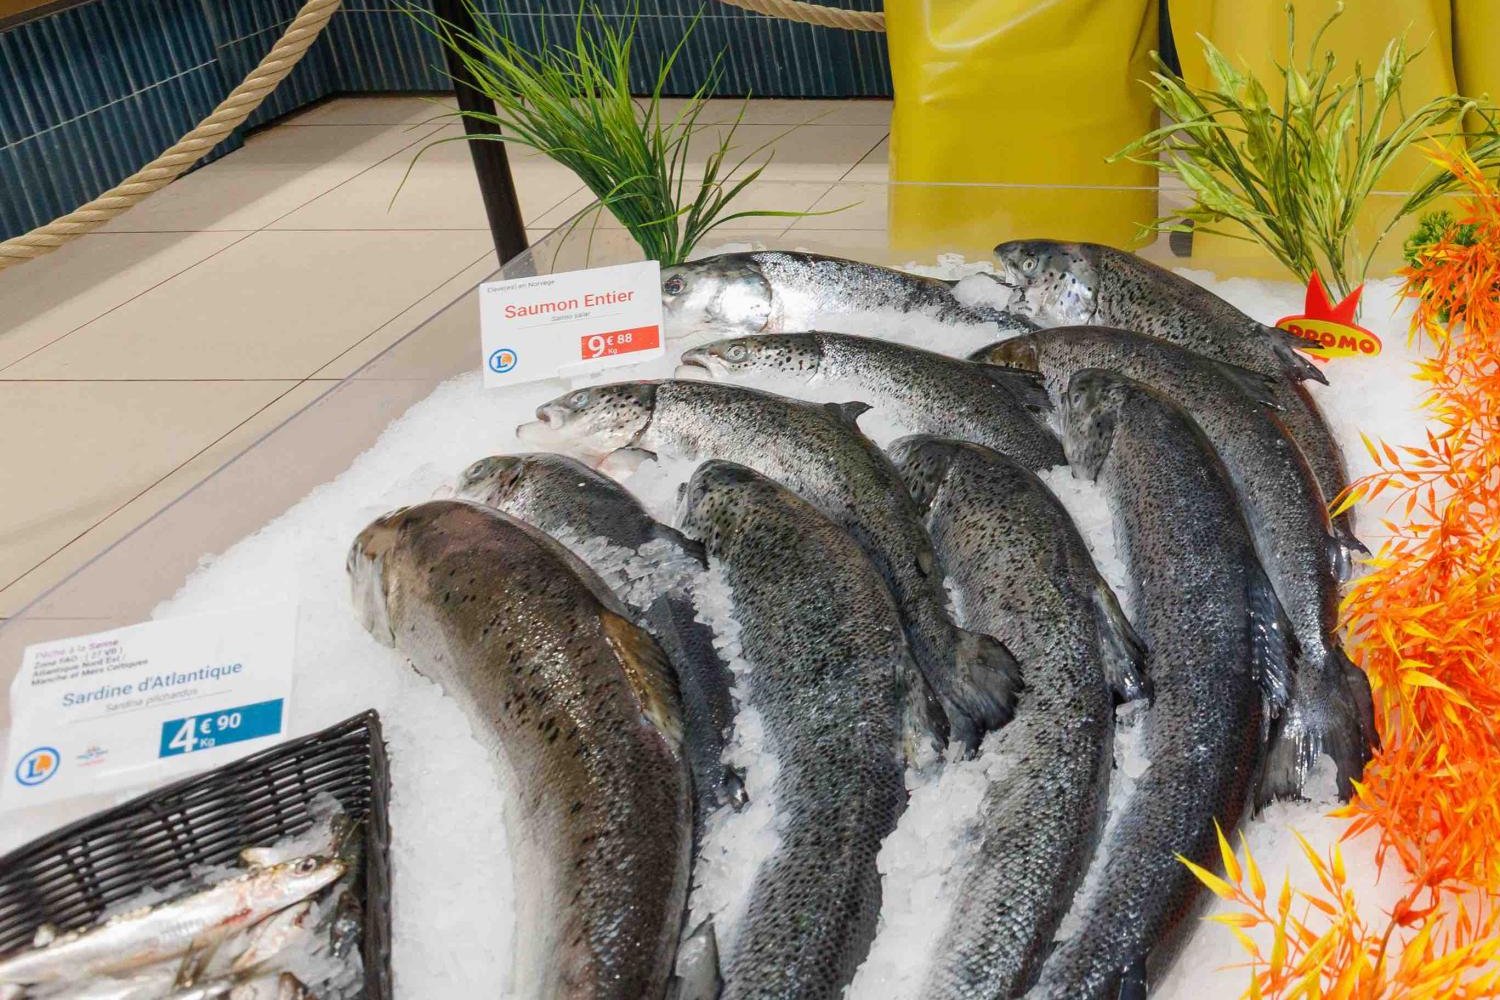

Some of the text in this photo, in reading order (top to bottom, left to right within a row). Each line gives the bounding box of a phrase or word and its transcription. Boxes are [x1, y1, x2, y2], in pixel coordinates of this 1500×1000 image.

[504, 289, 634, 319] Saumon Entier
[588, 333, 632, 358] 9 € 88
[62, 661, 244, 708] Sardine d'Atlantique
[168, 712, 242, 753] 4 € 90
